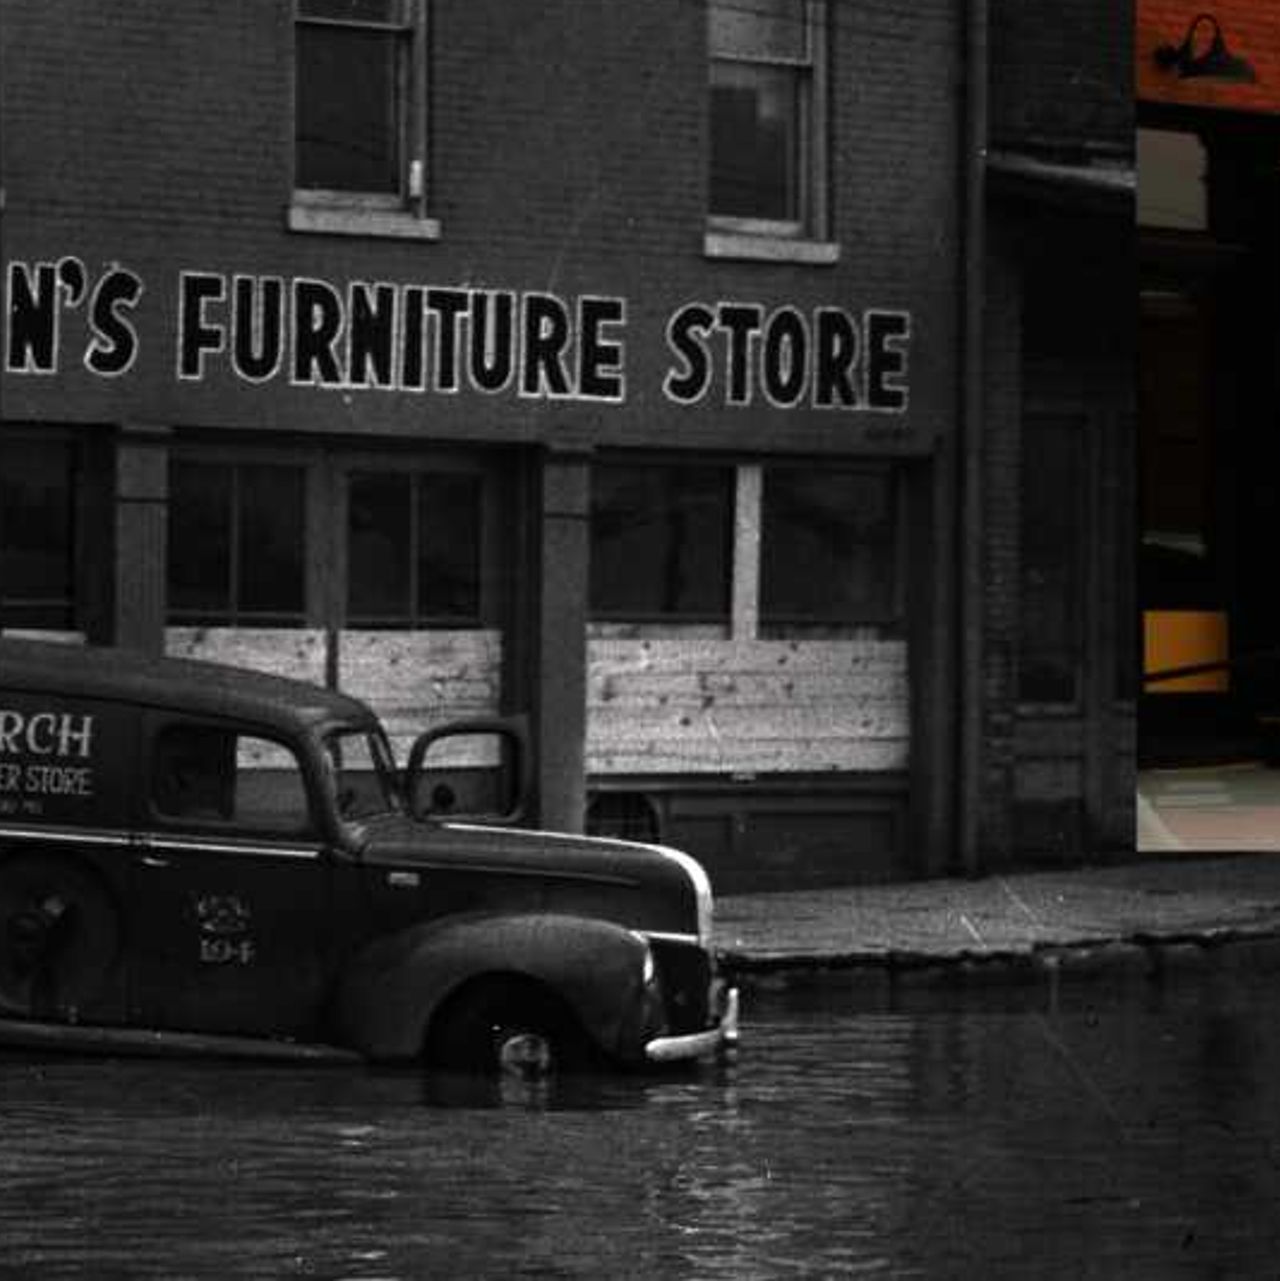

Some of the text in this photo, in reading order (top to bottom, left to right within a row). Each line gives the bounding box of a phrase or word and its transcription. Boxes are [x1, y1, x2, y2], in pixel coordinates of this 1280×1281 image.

[175, 271, 627, 404] FURNITURE
[662, 300, 912, 413] STORE
[24, 765, 95, 796] STORE
